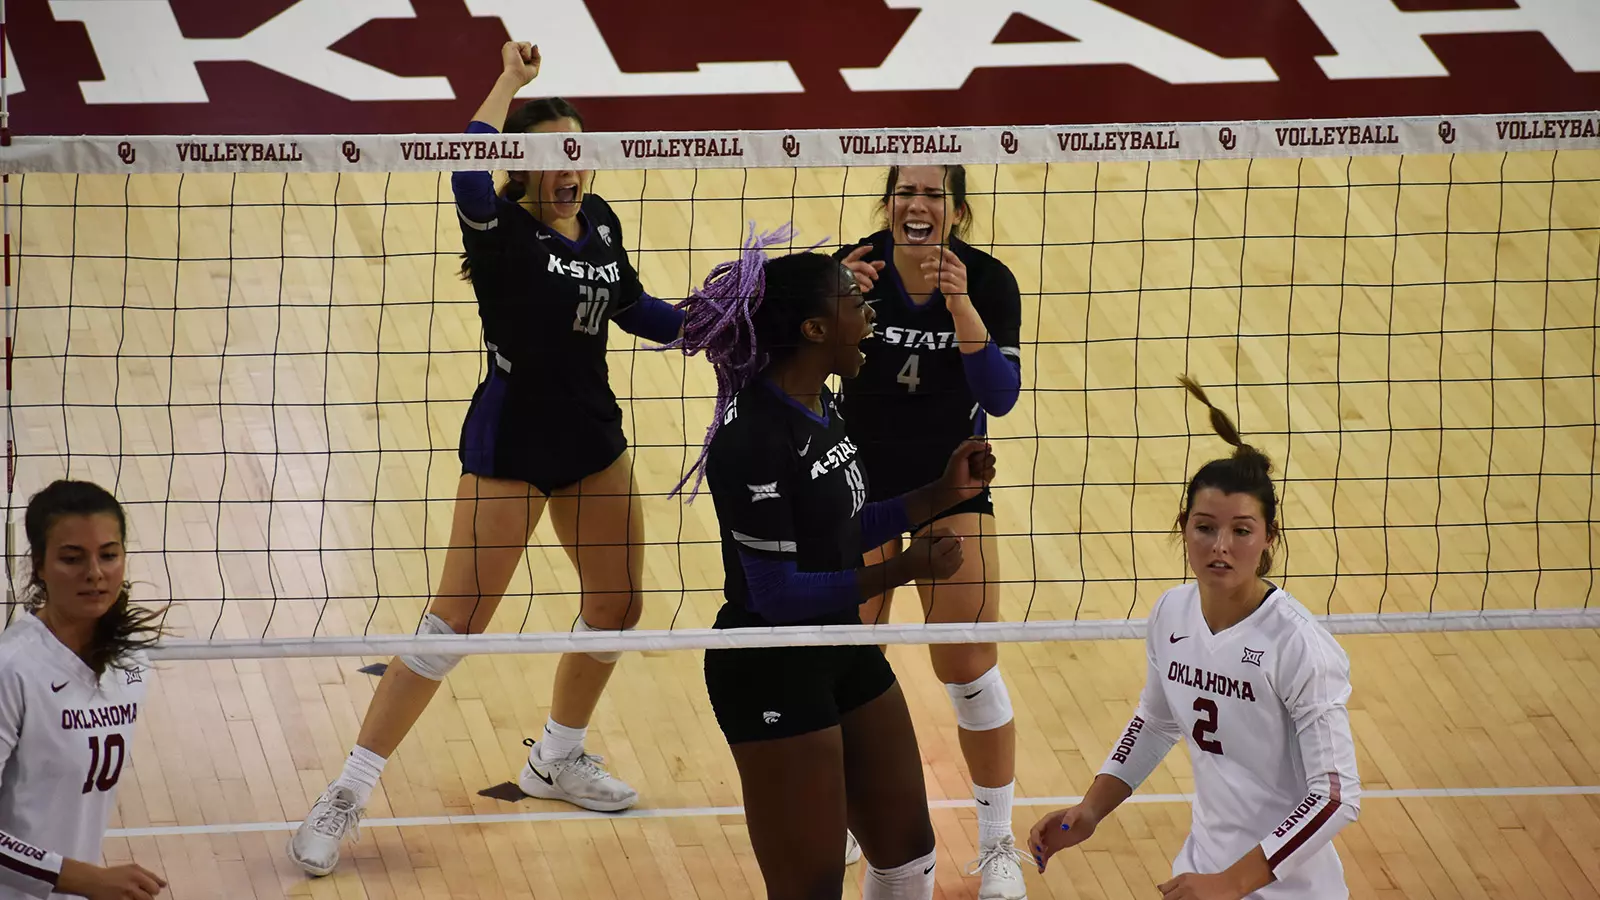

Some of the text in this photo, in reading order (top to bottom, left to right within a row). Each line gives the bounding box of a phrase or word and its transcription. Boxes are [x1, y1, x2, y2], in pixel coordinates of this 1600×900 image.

[0, 0, 1600, 104] KLAH
[118, 142, 136, 164] OU
[176, 142, 303, 162] VOLLEYBALL
[343, 140, 361, 163] OU
[400, 140, 524, 161] VOLLEYBALL
[563, 137, 581, 161] OU
[621, 137, 744, 158] VOLLEYBALL
[782, 134, 800, 157] OU
[839, 134, 962, 155] VOLLEYBALL
[1001, 131, 1018, 154] OU
[1057, 130, 1180, 151] VOLLEYBALL
[1219, 127, 1236, 150] OU
[1275, 125, 1398, 147] VOLLEYBALL
[1438, 121, 1456, 144] OU
[547, 253, 621, 284] K-STATE
[573, 285, 610, 336] 20
[871, 322, 959, 350] -STAT
[897, 354, 920, 393] 4
[1167, 660, 1256, 703] OKLAHOMA
[61, 702, 137, 730] OKLAHOMA
[1192, 697, 1224, 756] 2
[82, 733, 125, 795] 10
